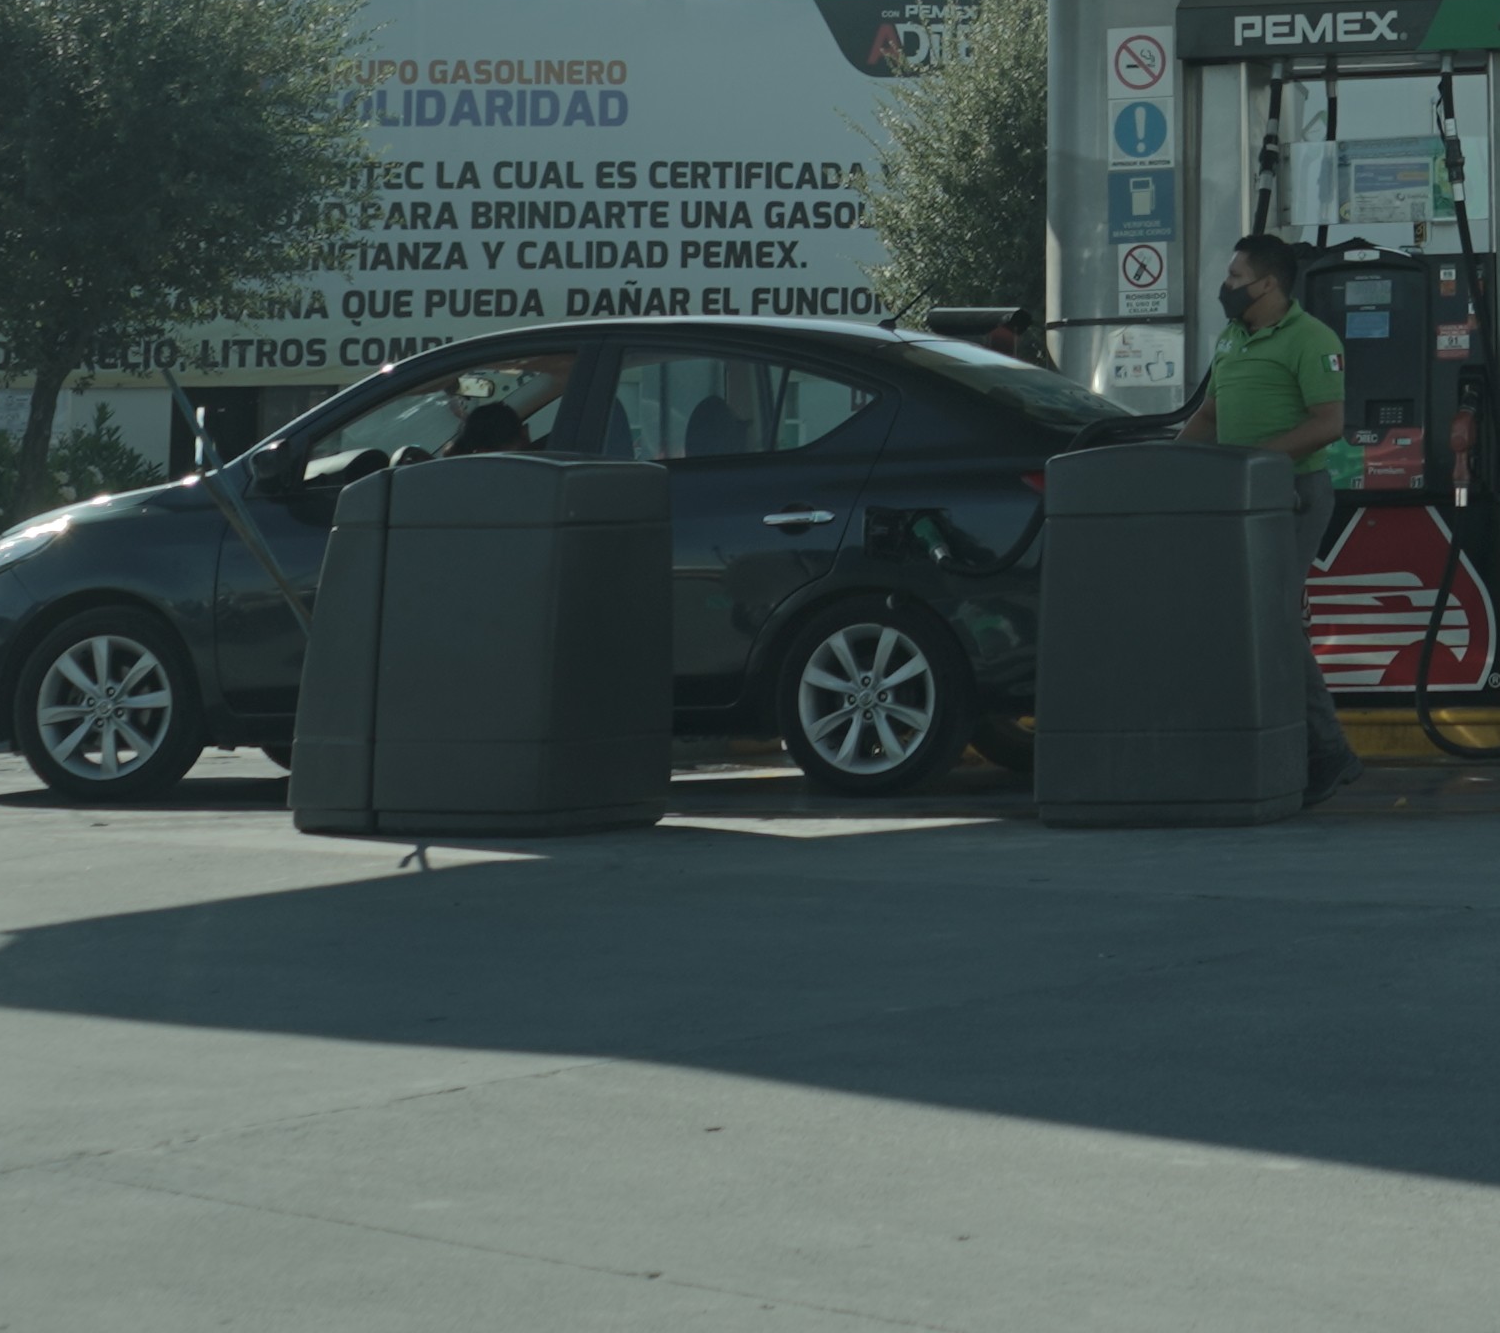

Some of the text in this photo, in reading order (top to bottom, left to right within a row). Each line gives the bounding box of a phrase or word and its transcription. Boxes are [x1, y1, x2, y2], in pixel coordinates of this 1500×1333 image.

[881, 10, 899, 18] CON
[1233, 10, 1399, 46] PEMEX
[428, 59, 628, 85] GASOLINERO
[326, 89, 629, 127] OLIDARIDAD
[436, 160, 867, 190] LA CUAL ES CERTIFICADA
[359, 201, 459, 230] PARA
[471, 201, 670, 230] BRINDARTE
[680, 200, 753, 229] UNA
[481, 241, 505, 270] Y
[516, 240, 669, 270] CALIDAD
[680, 240, 808, 269] PEMEX.
[342, 288, 413, 327] QUE
[423, 288, 544, 319] PUEDA
[566, 279, 691, 317] DAÑAR
[701, 287, 732, 316] EL
[200, 337, 327, 368] LITROS
[1447, 336, 1458, 345] 91
